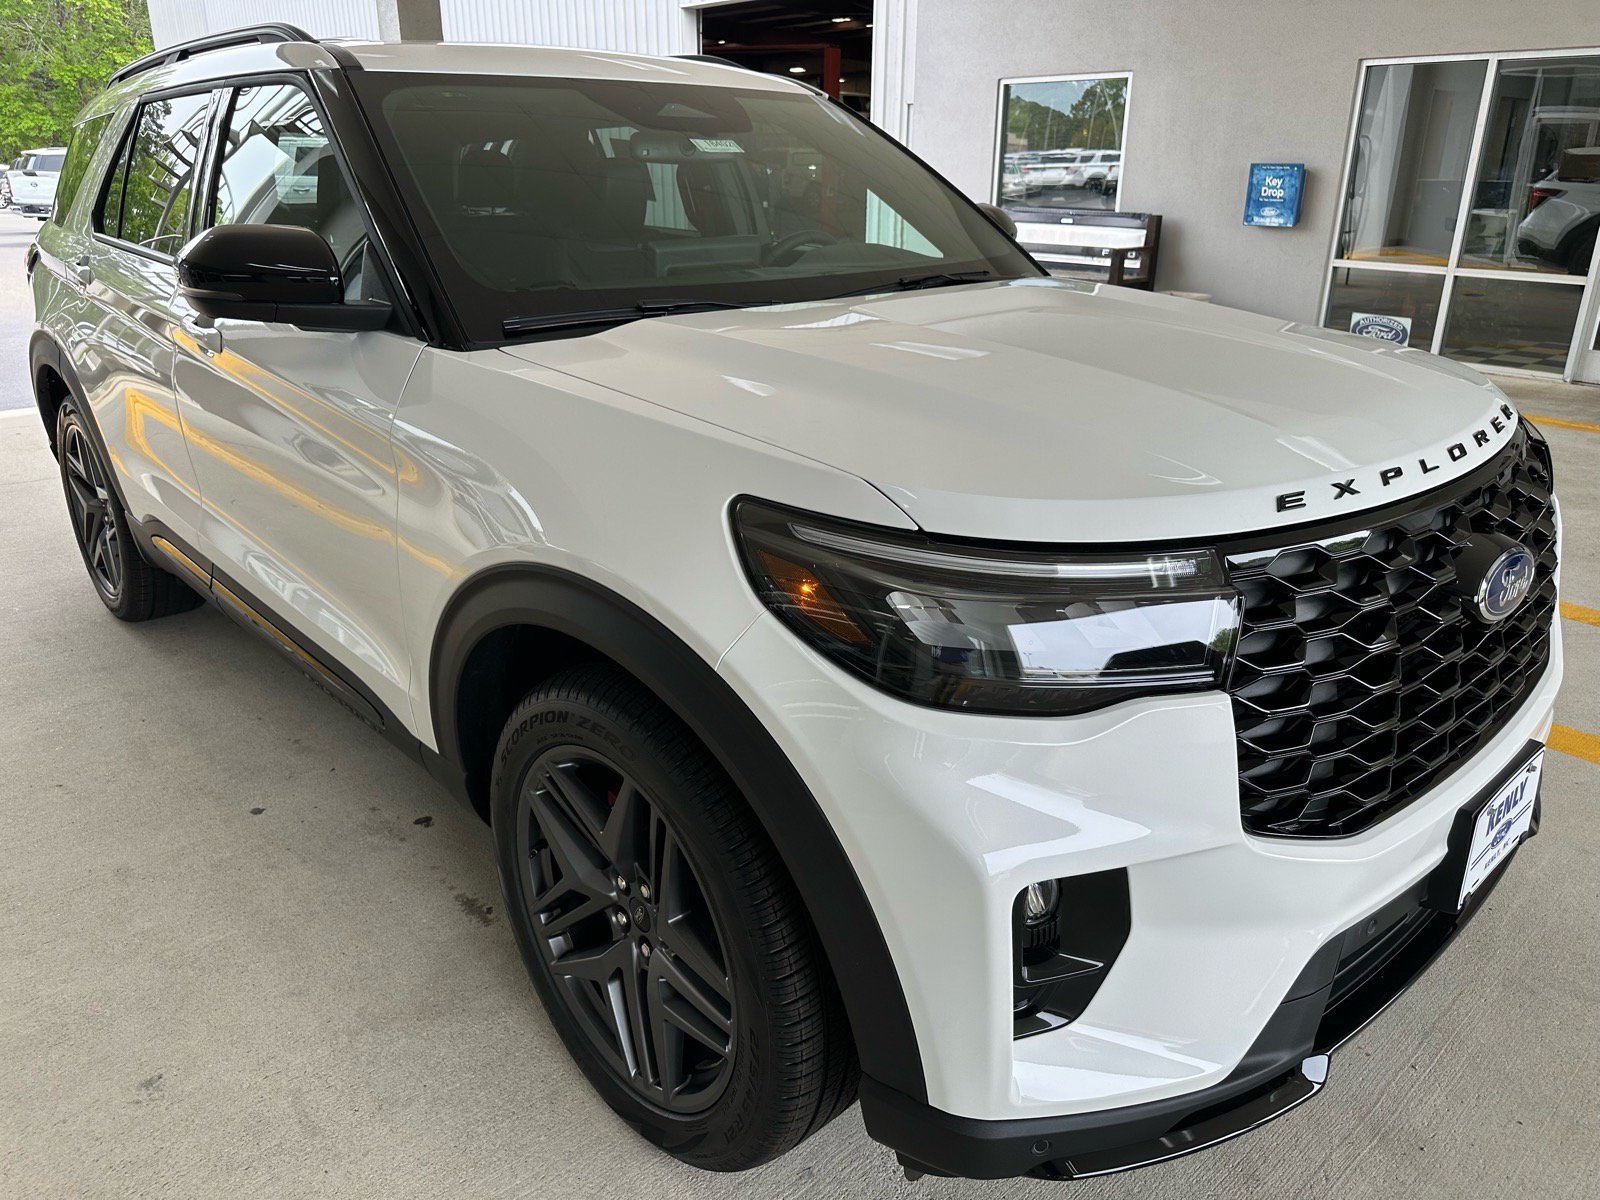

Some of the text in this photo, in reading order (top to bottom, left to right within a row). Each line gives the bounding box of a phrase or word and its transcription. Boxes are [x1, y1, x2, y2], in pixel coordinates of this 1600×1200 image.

[1261, 186, 1284, 199] Drop
[1265, 176, 1283, 188] Key
[1359, 316, 1404, 330] AUTHORIZED
[1362, 325, 1396, 340] Ford
[1276, 403, 1514, 513] EXPLORER
[1499, 562, 1529, 606] Ford
[500, 710, 635, 767] SCORPION ZERO
[1486, 775, 1529, 837] KENLY
